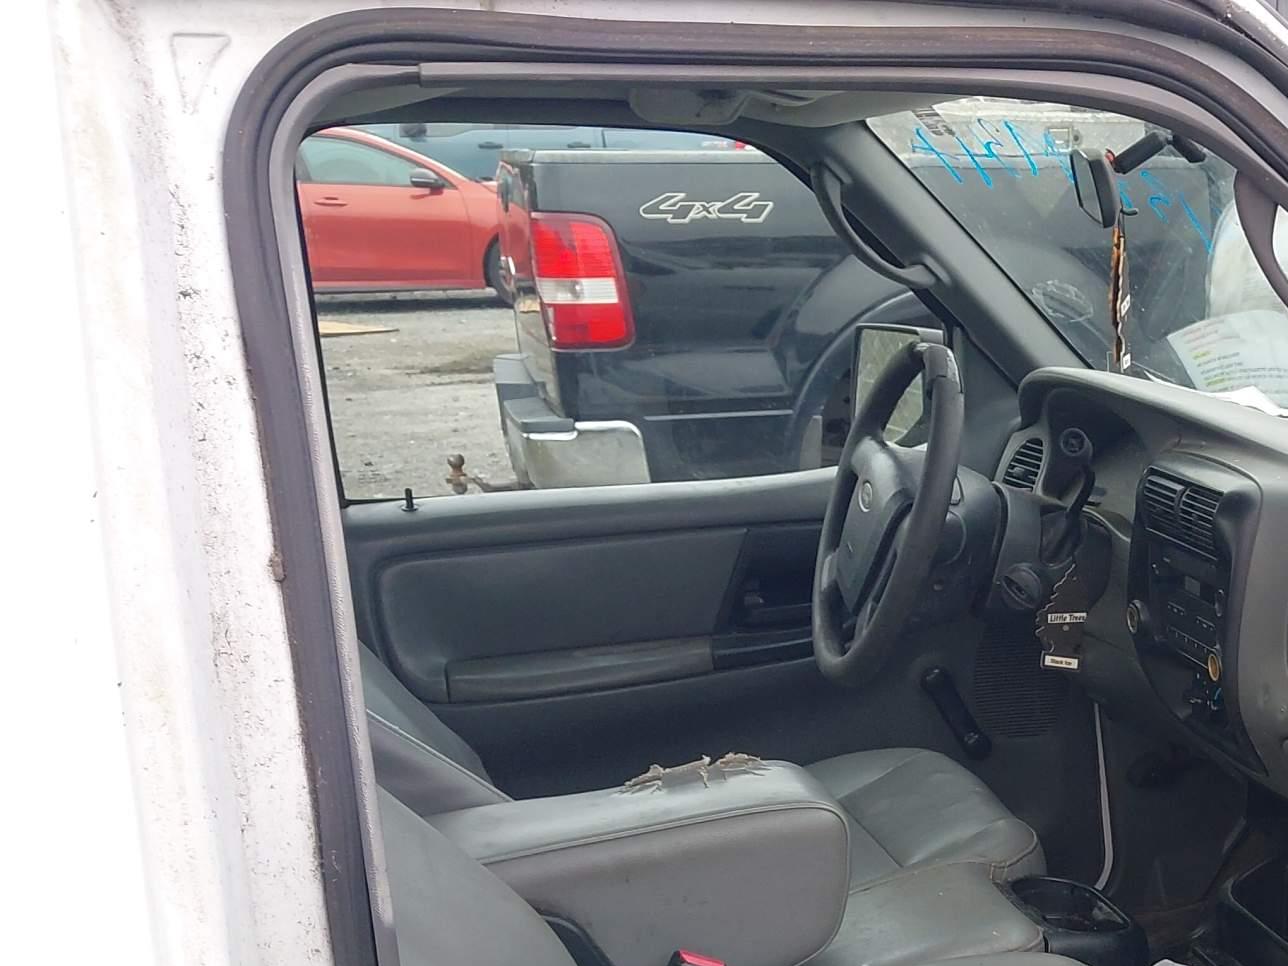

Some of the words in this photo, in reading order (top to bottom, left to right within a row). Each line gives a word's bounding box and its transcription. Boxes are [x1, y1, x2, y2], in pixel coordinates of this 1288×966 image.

[640, 192, 774, 223] 4x4
[1050, 613, 1069, 623] Little
[1069, 613, 1085, 622] Trees
